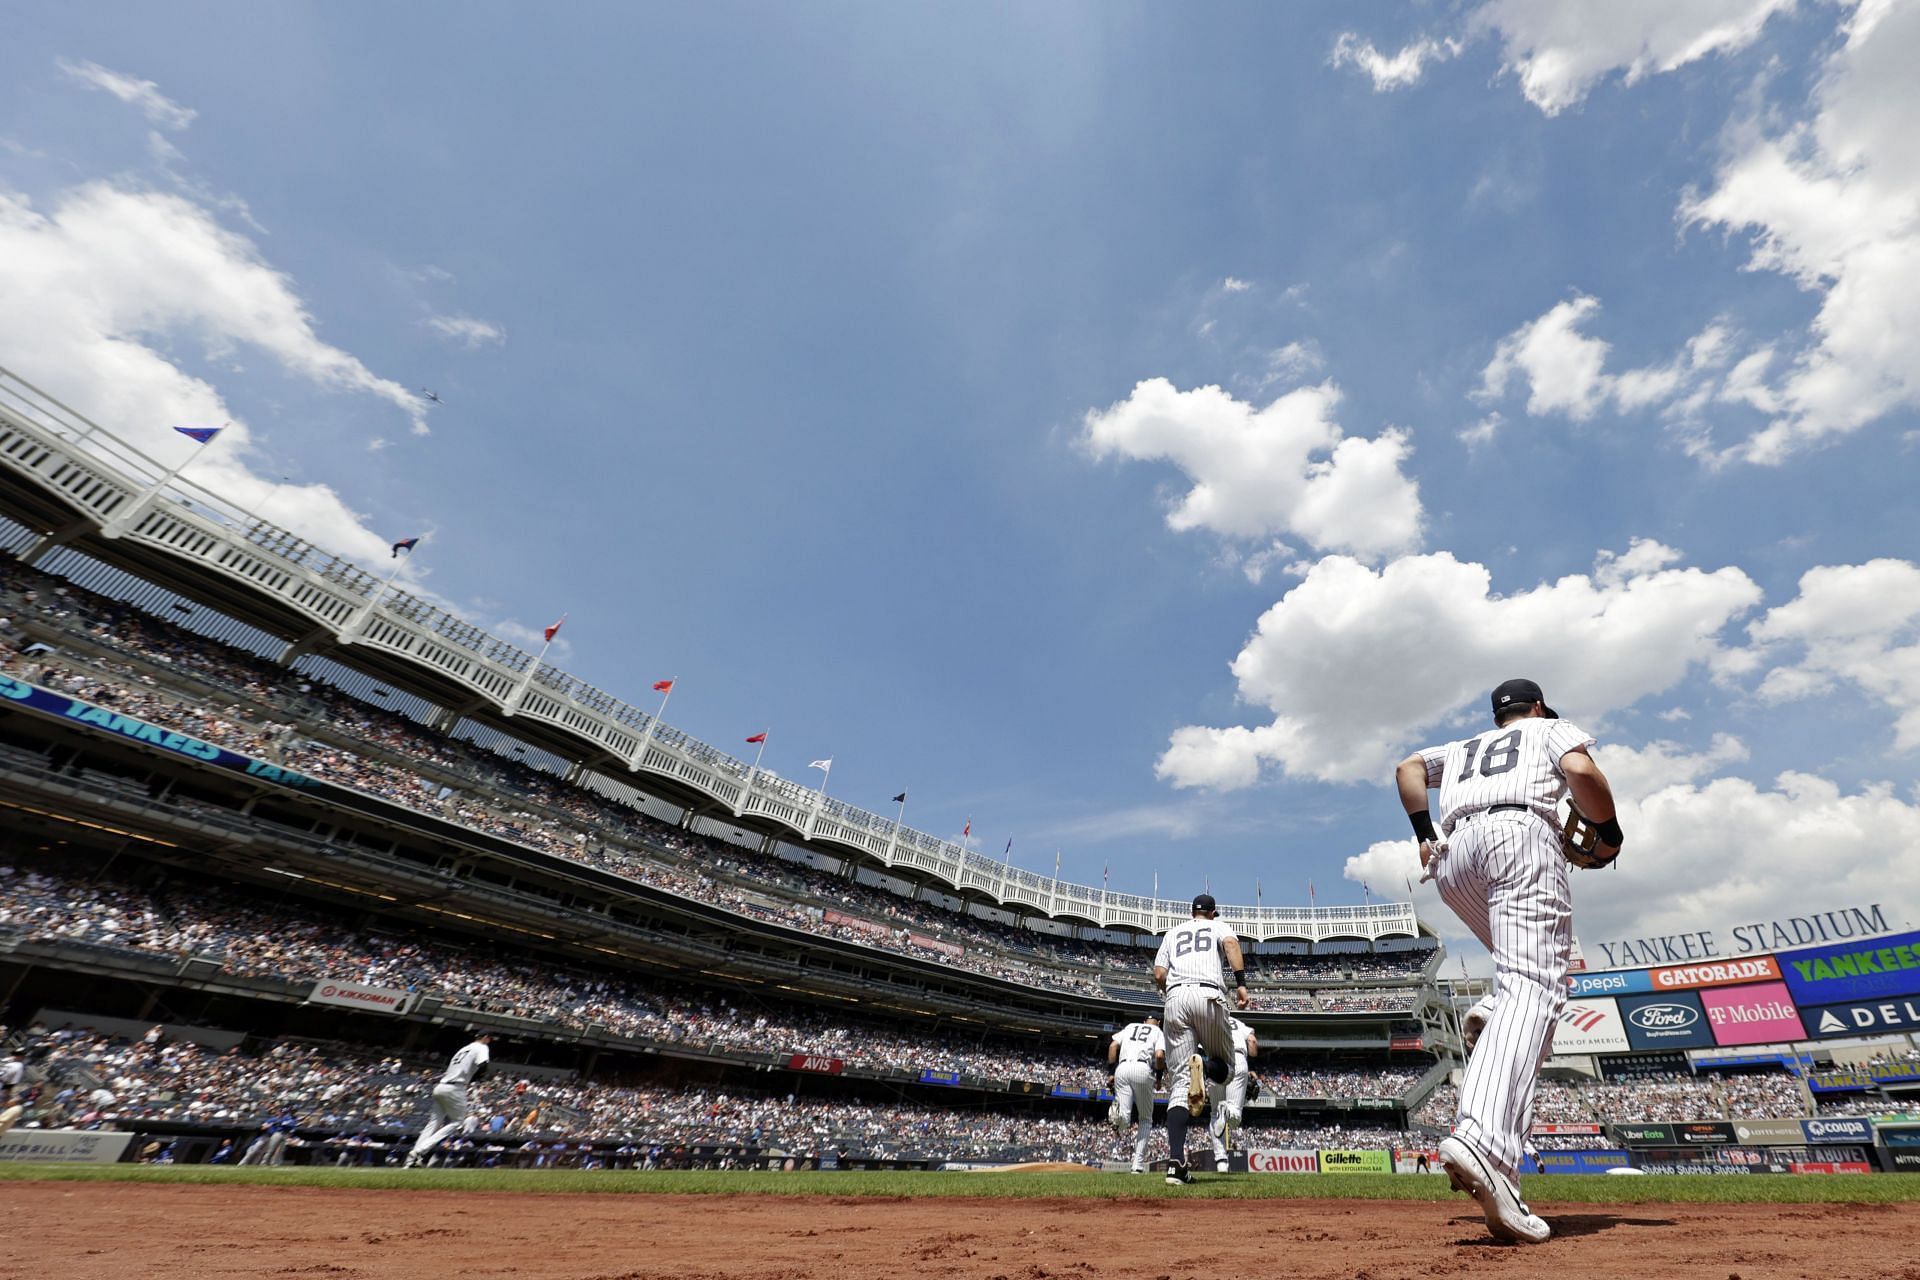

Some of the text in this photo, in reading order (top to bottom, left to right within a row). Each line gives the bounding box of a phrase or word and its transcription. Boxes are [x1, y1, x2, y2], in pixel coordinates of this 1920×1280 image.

[65, 700, 220, 760] YANKEES
[1458, 729, 1522, 783] 18
[1175, 927, 1212, 957] 26
[1598, 904, 1893, 968] YANKEE STADIUM
[1658, 959, 1772, 986] GATORADE
[1582, 974, 1627, 992] pepsi
[338, 990, 395, 1004] KIKKOMAN
[1642, 1007, 1686, 1026] Ford
[1730, 1002, 1796, 1025] Mobile
[1130, 1025, 1152, 1042] 12
[1588, 1037, 1625, 1046] AMERICA
[801, 1057, 832, 1071] AVIS
[1624, 1130, 1665, 1139] Uber Eats
[1825, 1121, 1865, 1136] coupa
[1249, 1152, 1316, 1172] Canon
[1641, 1164, 1750, 1175] StubHub StubHub StubHub
